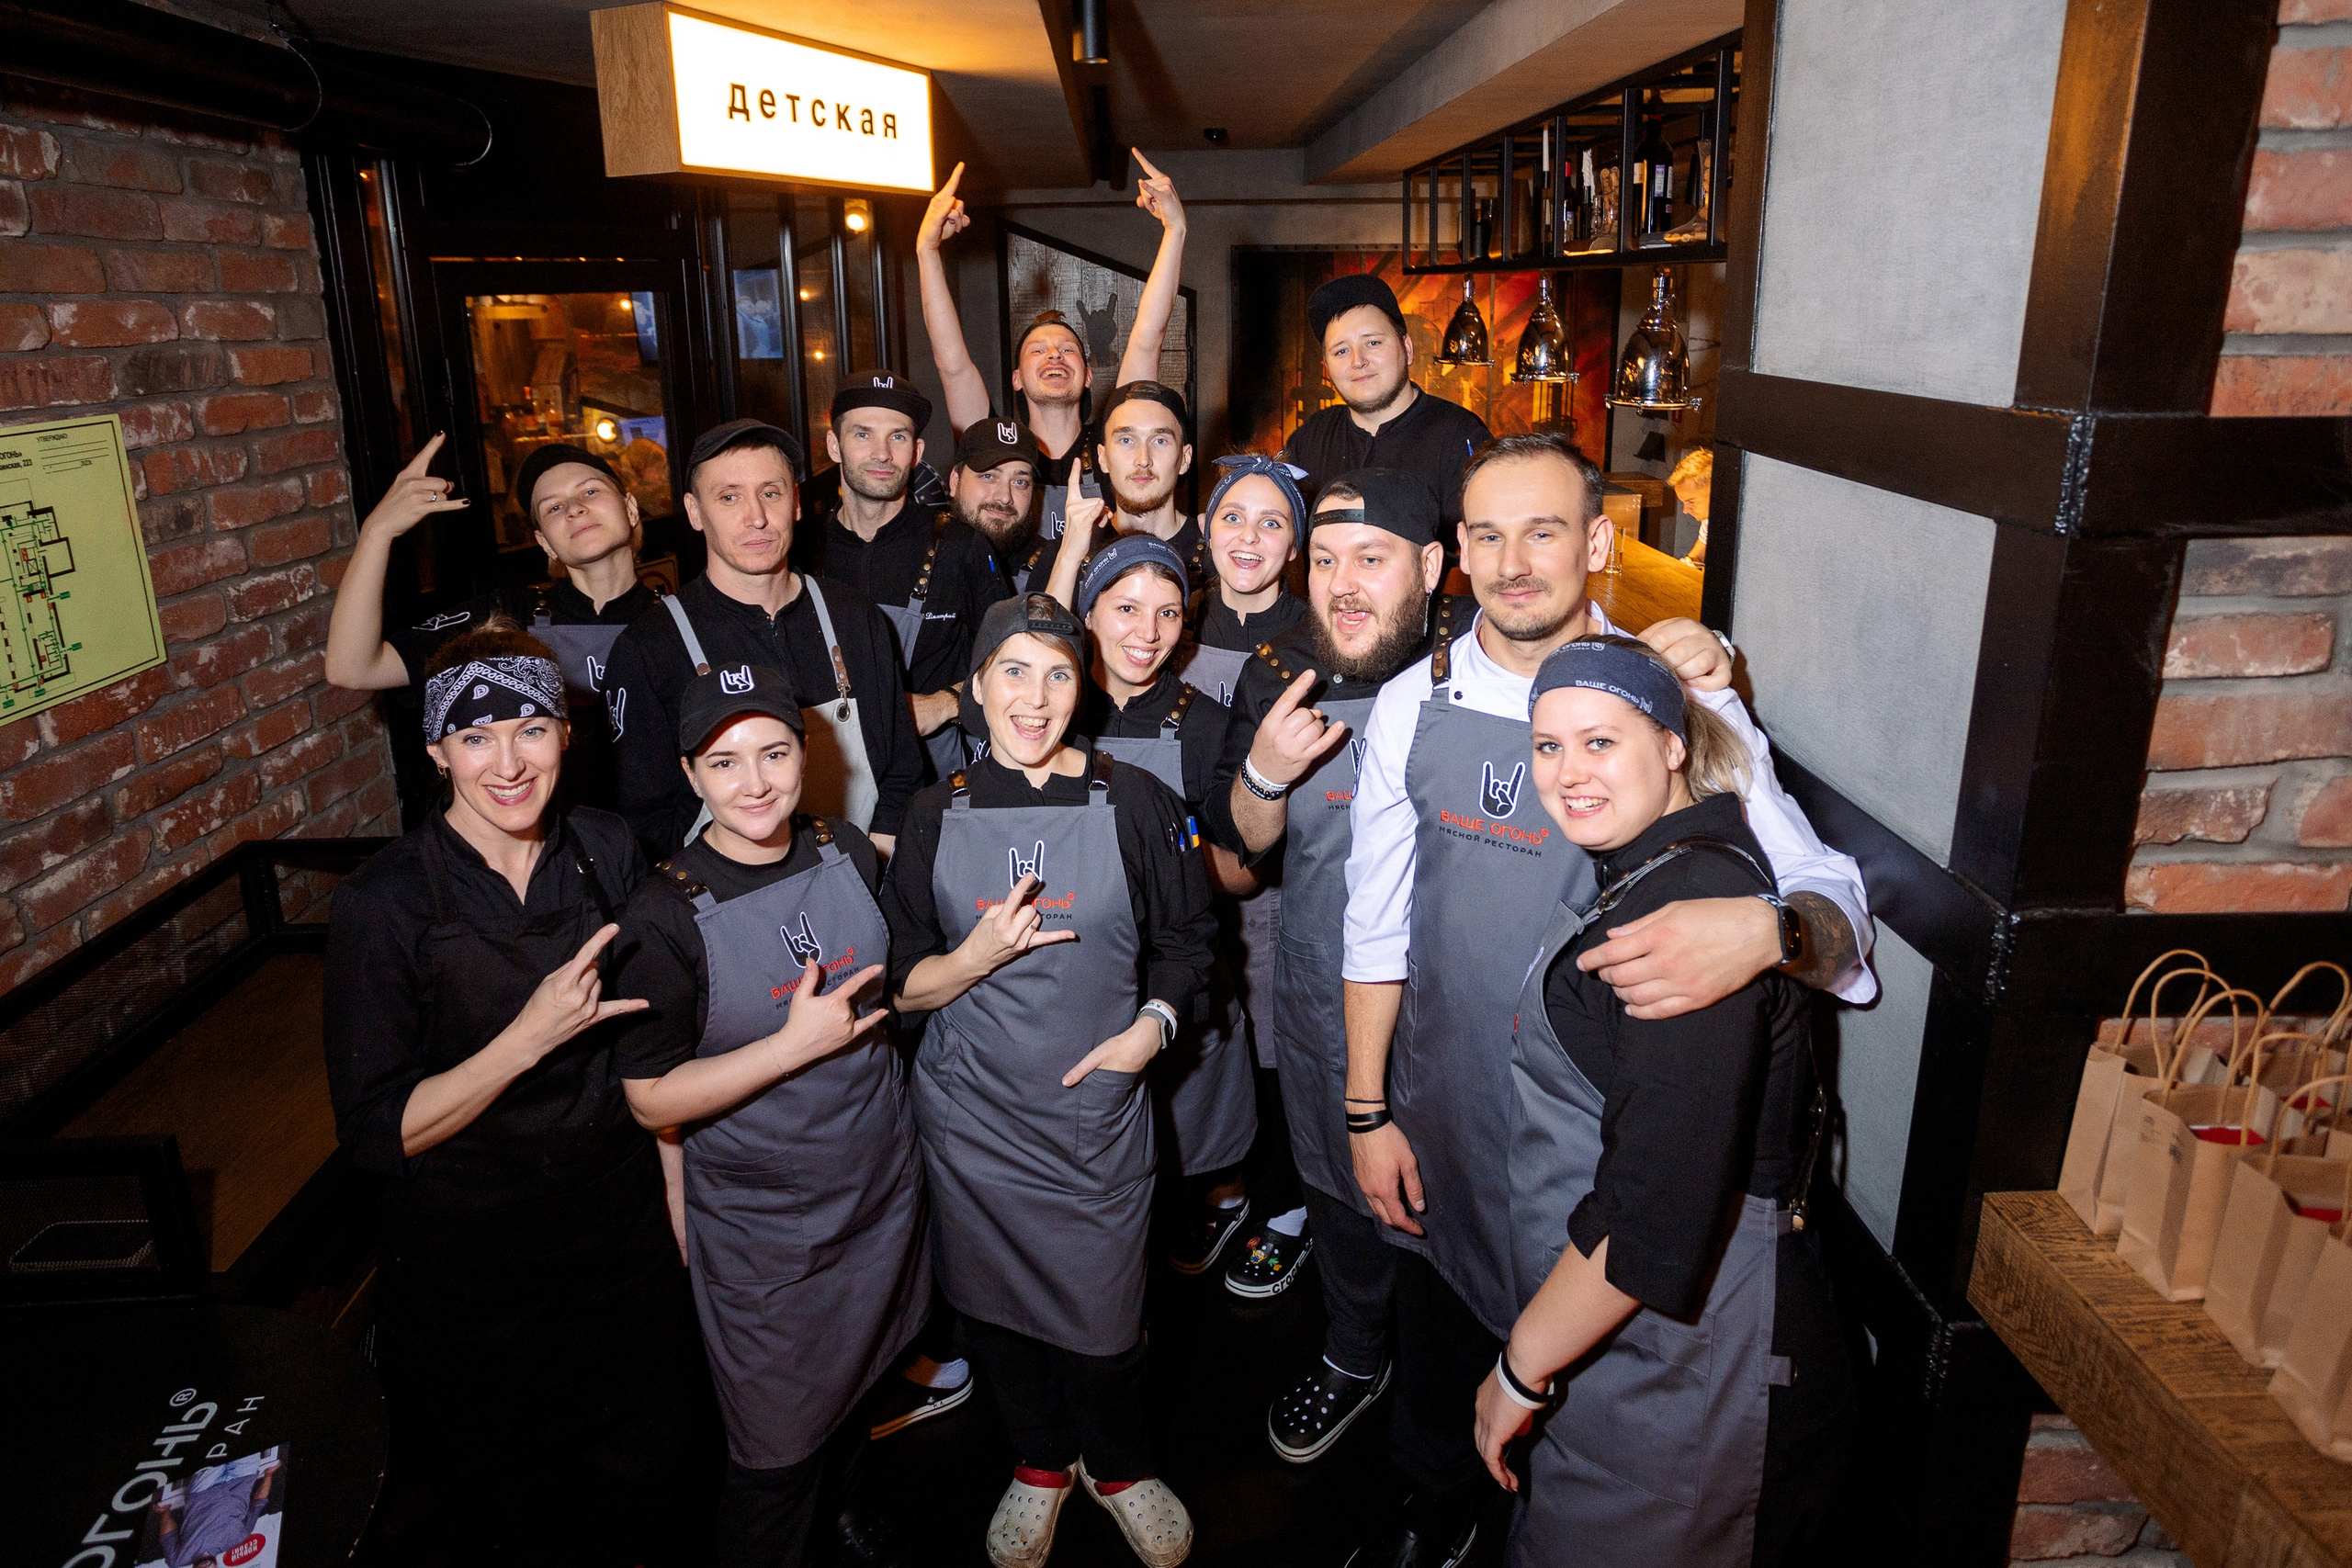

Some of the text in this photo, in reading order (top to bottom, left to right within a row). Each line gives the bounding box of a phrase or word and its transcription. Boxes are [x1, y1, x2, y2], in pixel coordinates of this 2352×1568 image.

[728, 83, 898, 139] детская
[1575, 680, 1640, 704] ВАШЕ ОГОНЬ
[1325, 790, 1352, 801] ВАШ
[1440, 809, 1486, 832] ВАШЕ
[1438, 826, 1542, 858] МЯСНОЙ РЕСТОРАН
[770, 975, 804, 999] ВАШ
[827, 966, 860, 986] СТОРАН
